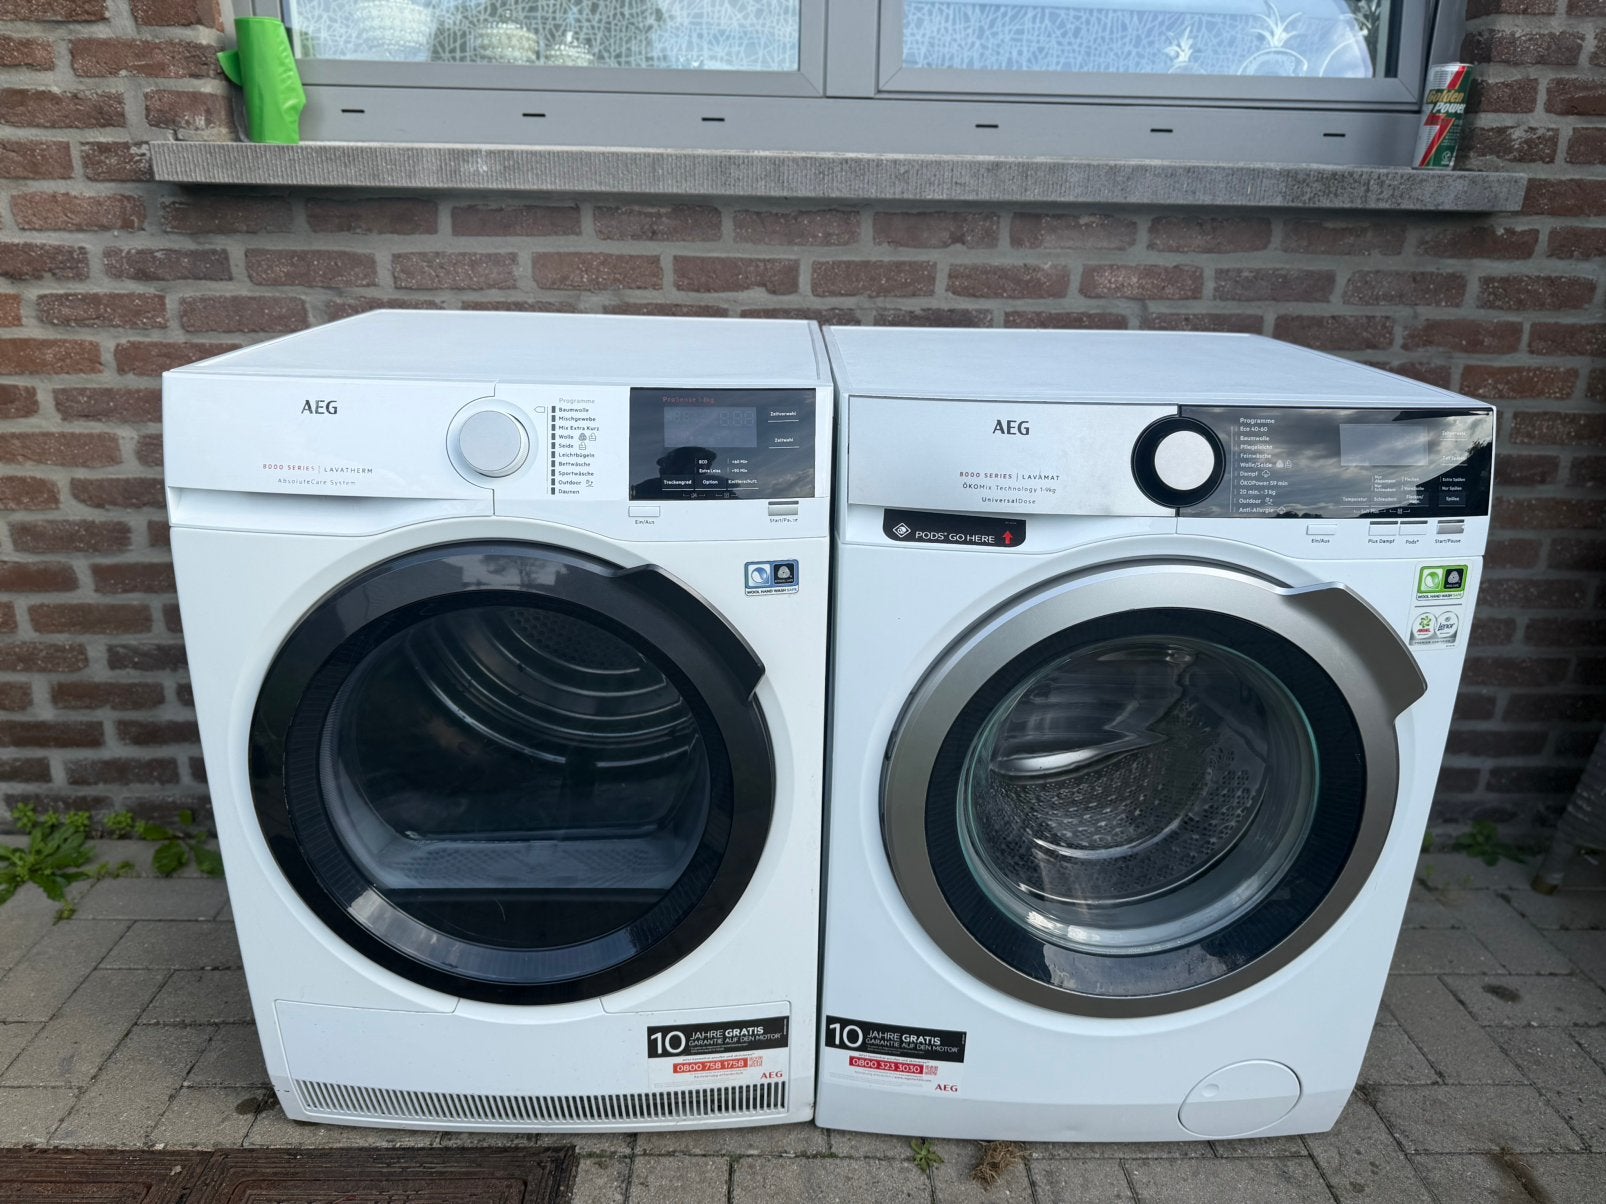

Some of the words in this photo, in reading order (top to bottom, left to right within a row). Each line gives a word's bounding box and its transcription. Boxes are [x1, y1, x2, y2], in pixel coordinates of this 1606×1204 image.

[1427, 90, 1464, 102] Golden
[1432, 102, 1466, 113] Power
[301, 400, 338, 415] AEG
[1239, 417, 1275, 425] Programme
[993, 419, 1030, 436] AEG
[324, 467, 374, 475] LAVATHERM
[959, 471, 981, 479] 8000
[984, 472, 1013, 480] SERIES
[1022, 474, 1061, 482] LAVAMAT
[277, 478, 327, 486] AbsoluteCare
[995, 484, 1038, 494] Technology
[981, 496, 1037, 505] UniversalDose
[949, 532, 965, 542] GO
[967, 534, 996, 544] HERE
[690, 1030, 723, 1040] JAHRE
[725, 1026, 764, 1037] GRATIS
[829, 1023, 864, 1048] 10
[867, 1030, 900, 1042] JAHRE
[902, 1034, 941, 1048] GRATIS
[651, 1031, 686, 1054] 10
[689, 1038, 724, 1046] GARANTIE
[866, 1039, 900, 1050] GARANTIE
[902, 1044, 915, 1052] AUF
[917, 1045, 932, 1054] DEN
[677, 1064, 702, 1073] 0800
[705, 1062, 721, 1070] 758
[724, 1060, 744, 1069] 1758
[852, 1058, 877, 1069] 0800
[879, 1062, 895, 1071] 323
[897, 1063, 920, 1073] 3030
[761, 1071, 783, 1080] AEG
[935, 1084, 958, 1093] AEG
